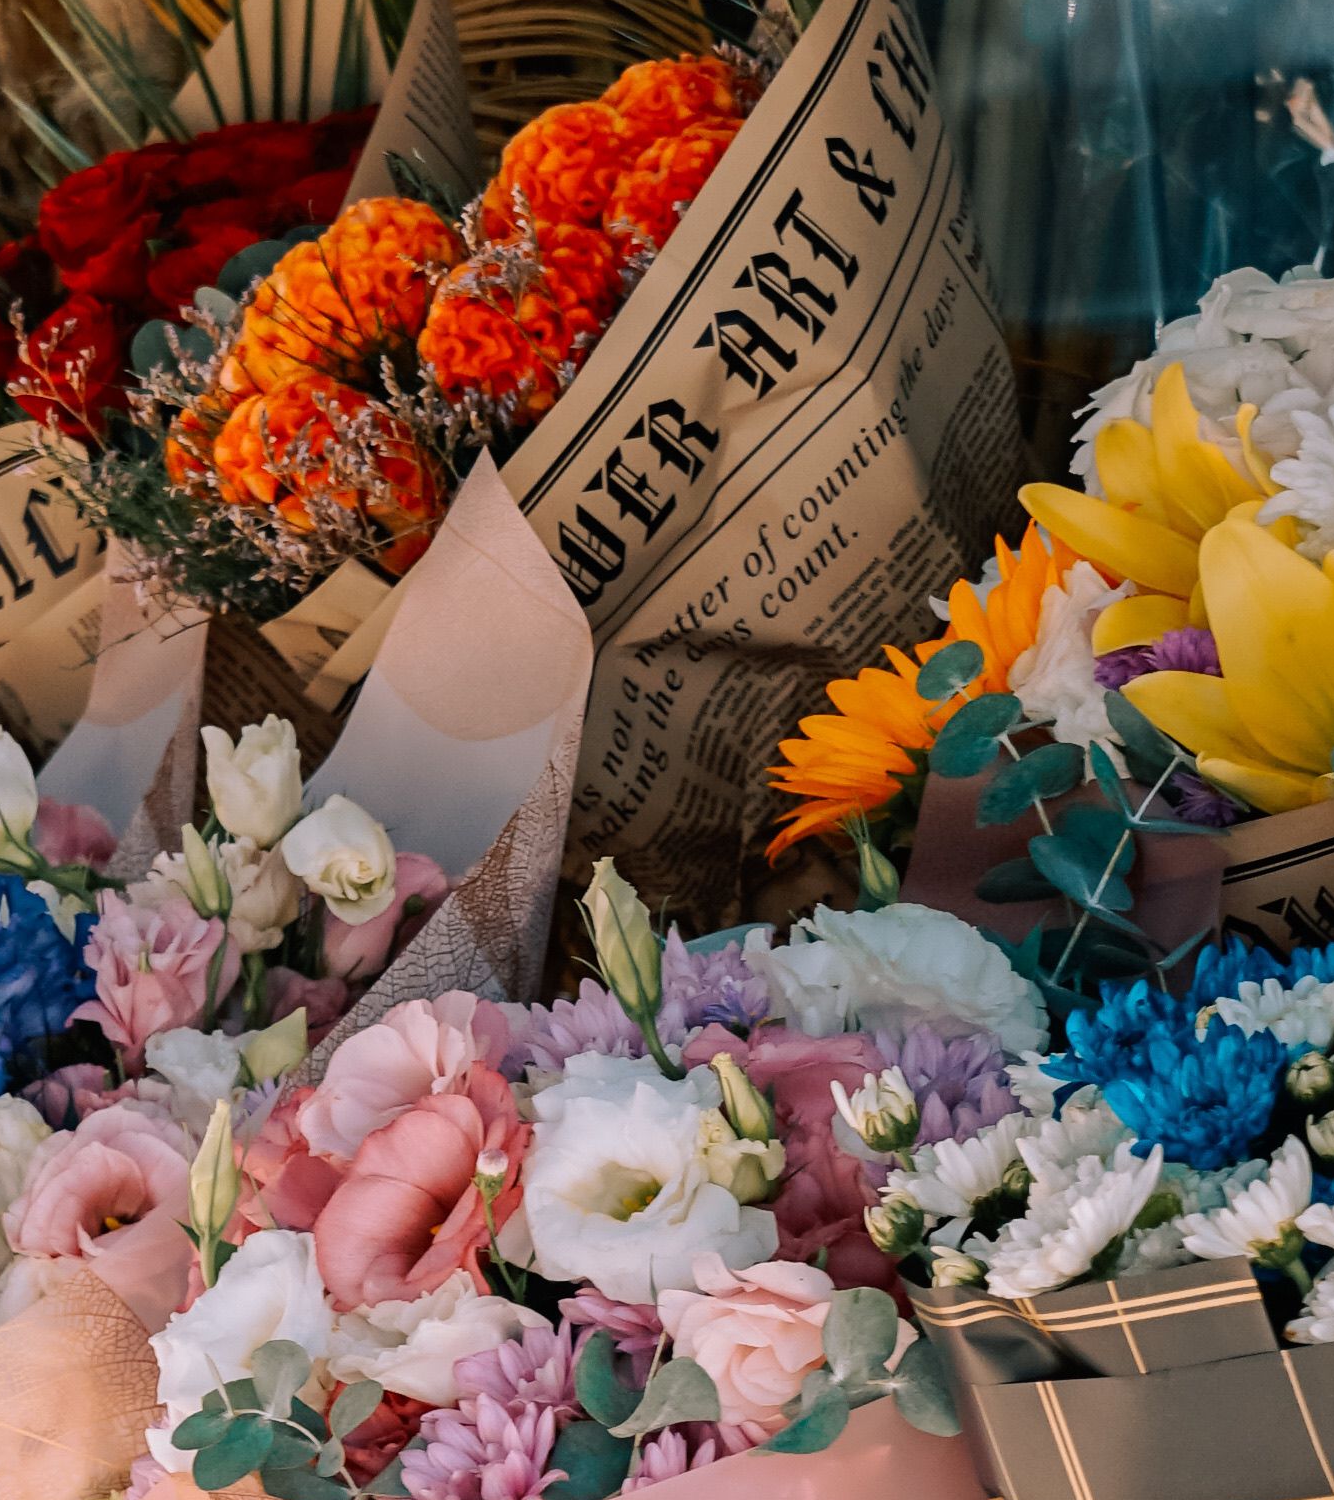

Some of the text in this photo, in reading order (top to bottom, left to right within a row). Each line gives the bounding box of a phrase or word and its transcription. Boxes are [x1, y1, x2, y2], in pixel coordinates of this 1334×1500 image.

[692, 187, 860, 402] ART
[824, 137, 896, 224] &
[574, 781, 602, 813] is
[601, 708, 633, 778] not
[620, 674, 640, 704] a
[634, 574, 731, 668] matter
[743, 523, 778, 578] of
[782, 400, 910, 540] counting
[898, 346, 925, 398] the
[580, 737, 668, 851] making
[645, 668, 684, 731] the
[685, 617, 754, 664] days
[759, 520, 861, 620] count.
